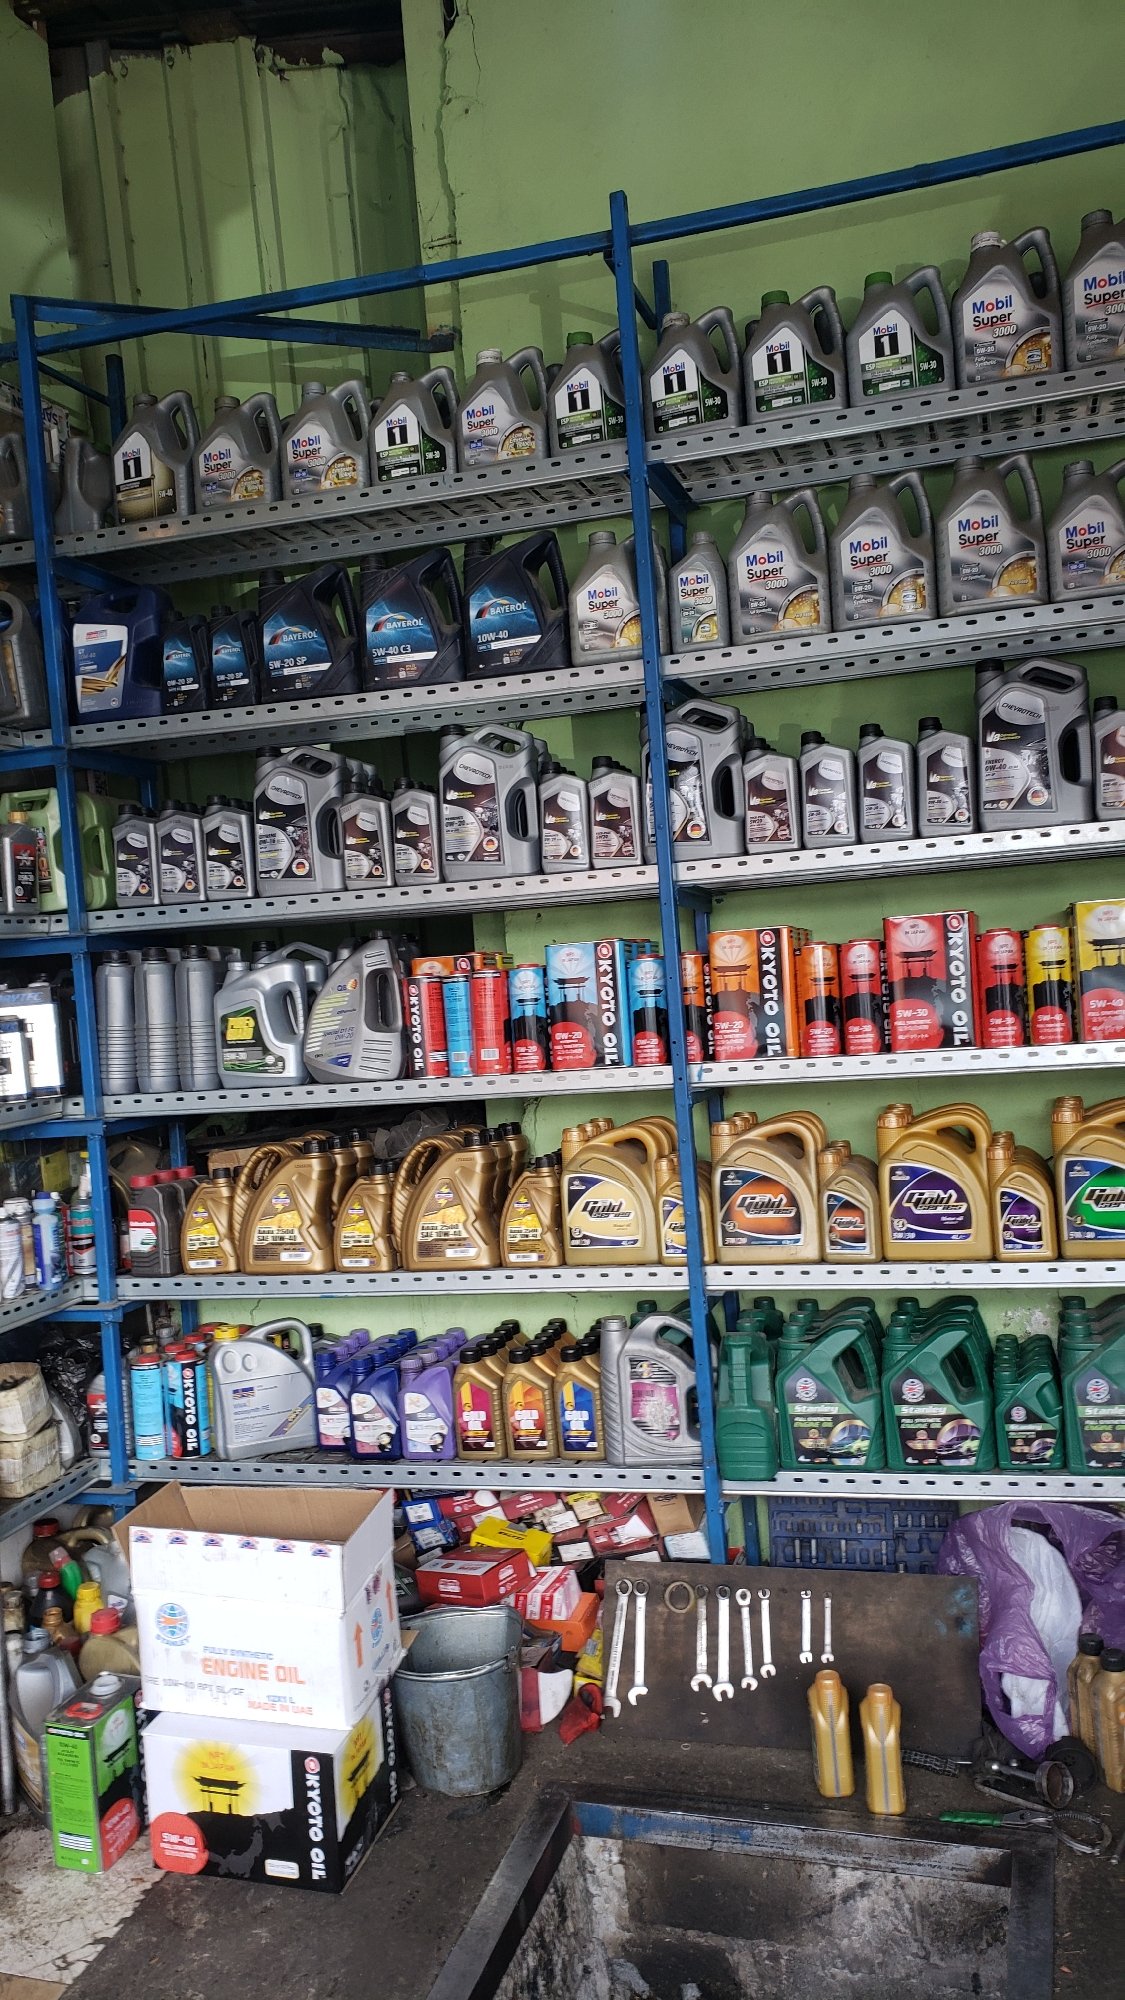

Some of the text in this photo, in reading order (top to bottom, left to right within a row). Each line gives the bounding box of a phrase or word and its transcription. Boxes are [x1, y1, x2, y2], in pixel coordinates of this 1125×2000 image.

[1083, 271, 1125, 292] Mobil
[972, 295, 1013, 315] Mobil
[1083, 289, 1125, 307] Super
[972, 311, 1012, 329] Super
[873, 323, 898, 336] Mobil
[992, 324, 1017, 339] 3000
[765, 341, 790, 353] Mobil
[662, 361, 686, 375] Mobil
[919, 360, 937, 373] 5W-30
[566, 380, 589, 392] Mobil
[811, 376, 828, 388] 5W-30
[705, 396, 722, 407] 5W-30
[466, 405, 495, 420] Mobil
[386, 416, 408, 427] Mobil
[467, 417, 495, 432] Super
[291, 434, 321, 449] Mobil
[121, 448, 141, 459] Mobil
[203, 448, 232, 463] Mobil
[292, 446, 321, 461] Super
[203, 460, 233, 475] Super
[307, 457, 326, 468] 3000
[218, 470, 236, 481] 3000
[958, 515, 999, 533] Mobil
[1065, 522, 1105, 539] Mobil
[850, 536, 888, 554] Mobil
[958, 532, 999, 547] Super
[1066, 535, 1106, 551] Super
[978, 544, 1002, 556] 3000
[1087, 547, 1111, 559] 3000
[746, 551, 784, 567] Mobil
[850, 552, 888, 567] Super
[747, 566, 784, 581] Super
[869, 564, 892, 576] 3000
[679, 574, 709, 587] Mobil
[765, 578, 788, 591] 3000
[587, 587, 618, 600] Mobil
[680, 587, 709, 599] Super
[490, 601, 528, 616] BAYEROL
[588, 598, 619, 611] Super
[603, 609, 623, 619] 3000
[386, 618, 424, 629] BAYEROL
[282, 630, 318, 642] BAYEROL
[477, 630, 509, 644] 10W-40
[371, 644, 412, 657] 5W-40 C3
[268, 656, 307, 670] 5W-20 SP
[1001, 702, 1042, 720] CHEVROTECH
[947, 932, 970, 1046] KYOTO OIL
[760, 946, 783, 1057] KYOTO OIL
[598, 959, 620, 1065] KYOTO OIL
[409, 995, 425, 1071] KYOTO OIL
[738, 1195, 785, 1213] Gold
[905, 1191, 953, 1210] Gold
[581, 1200, 623, 1218] Gold
[183, 1376, 198, 1451] KYOTO OIL
[794, 1405, 839, 1414] Stanley
[901, 1406, 947, 1415] Stanley
[1084, 1407, 1125, 1415] Stanle
[230, 1648, 274, 1661] SYNTHETIC
[201, 1656, 306, 1685] ENGINE OIL
[291, 1703, 314, 1716] UAE
[305, 1773, 328, 1881] KYOTO OIL
[162, 1831, 195, 1847] 5W-40
